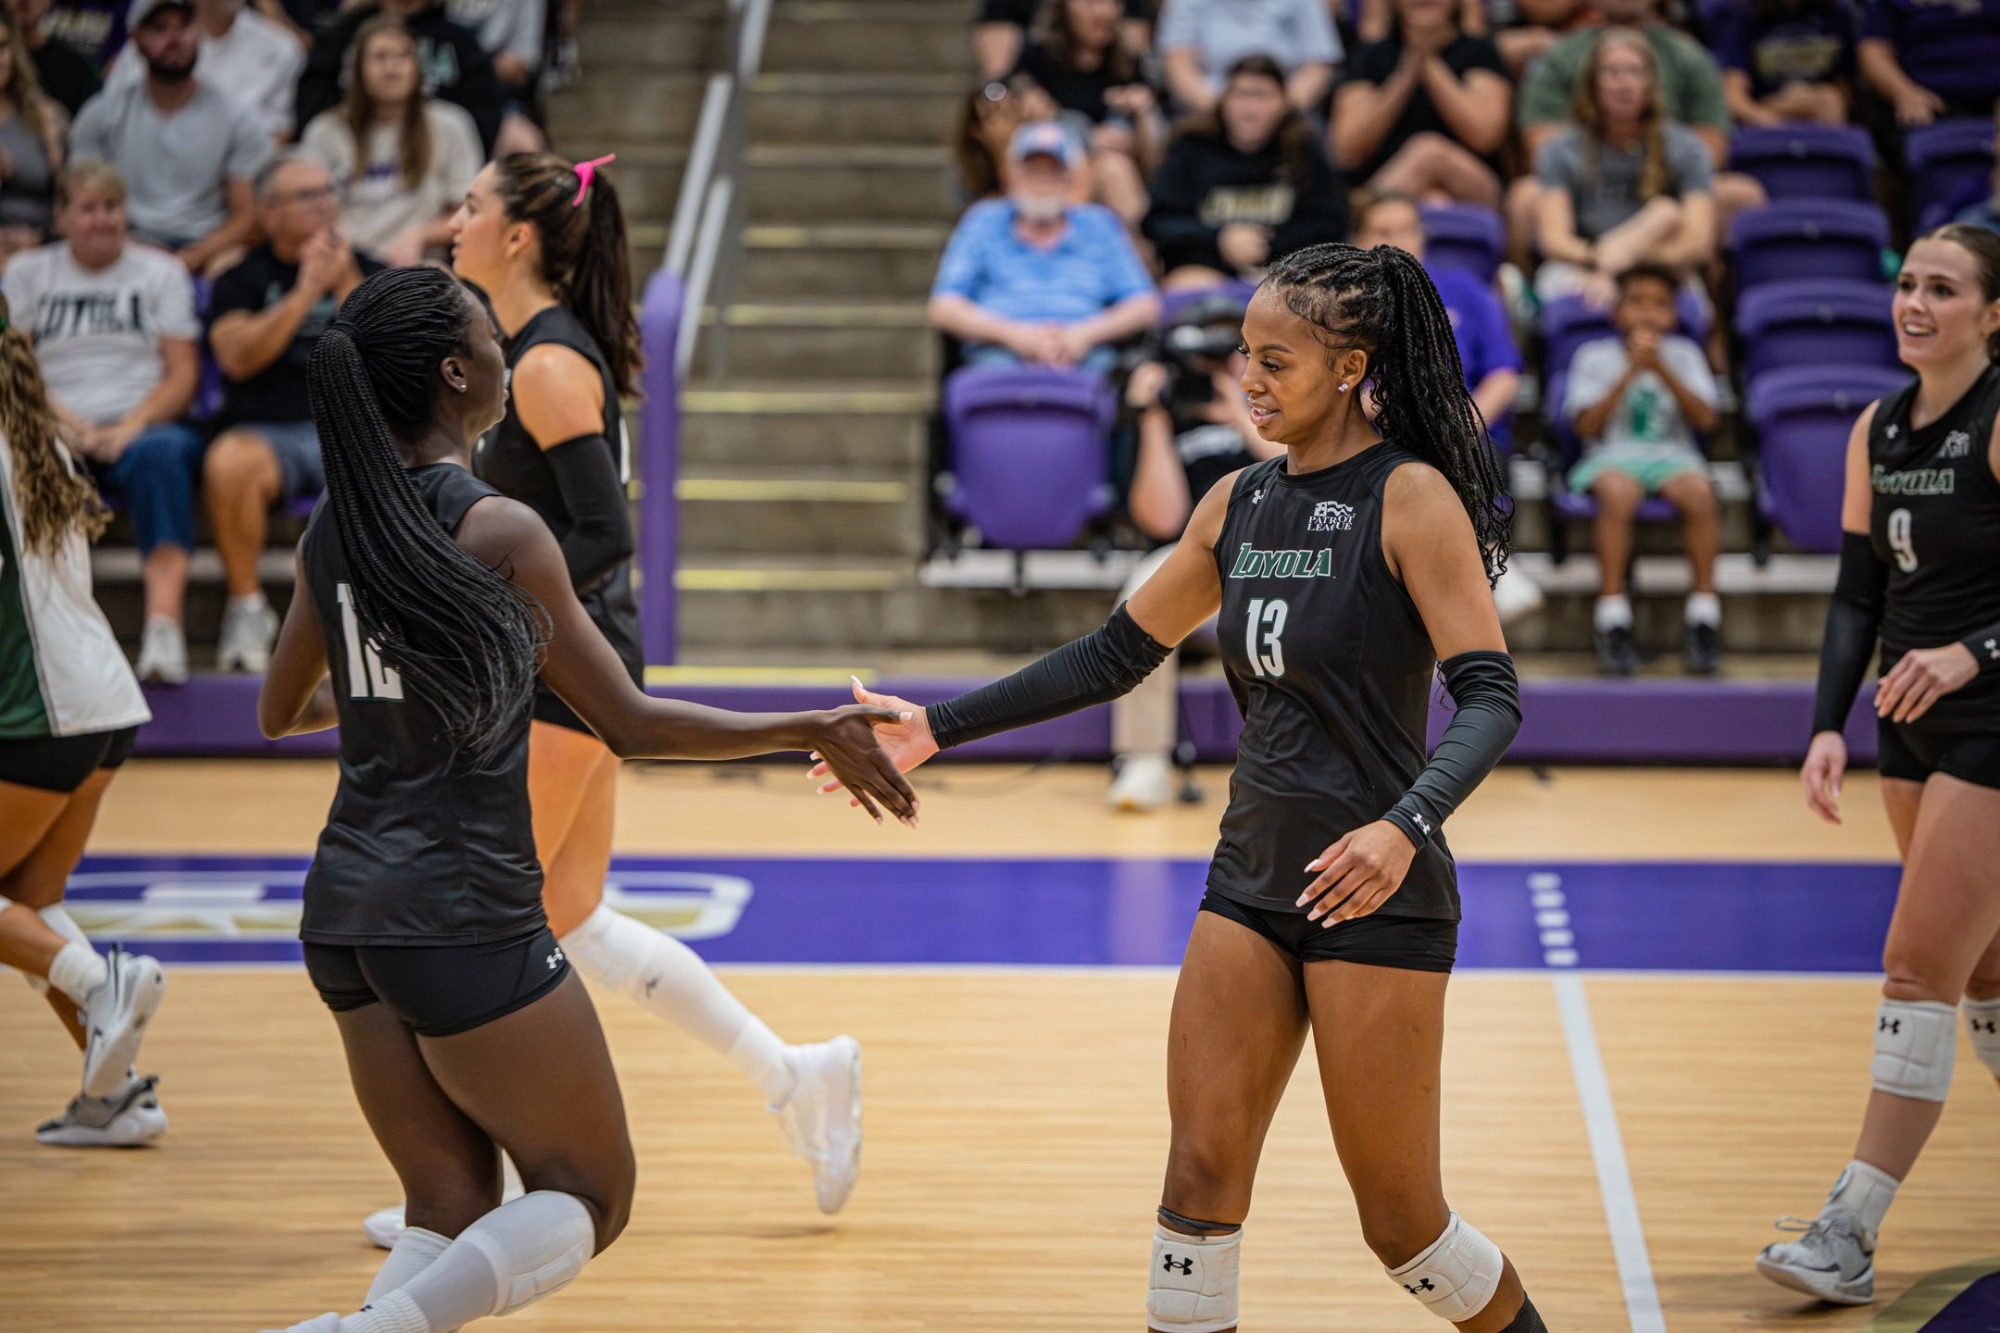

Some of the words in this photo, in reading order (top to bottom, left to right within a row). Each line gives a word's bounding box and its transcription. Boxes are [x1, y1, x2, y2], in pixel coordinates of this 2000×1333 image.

[1308, 515, 1352, 525] PATROT
[1887, 507, 1918, 573] 9
[1229, 542, 1332, 579] LOYOLA
[1246, 598, 1288, 677] 13
